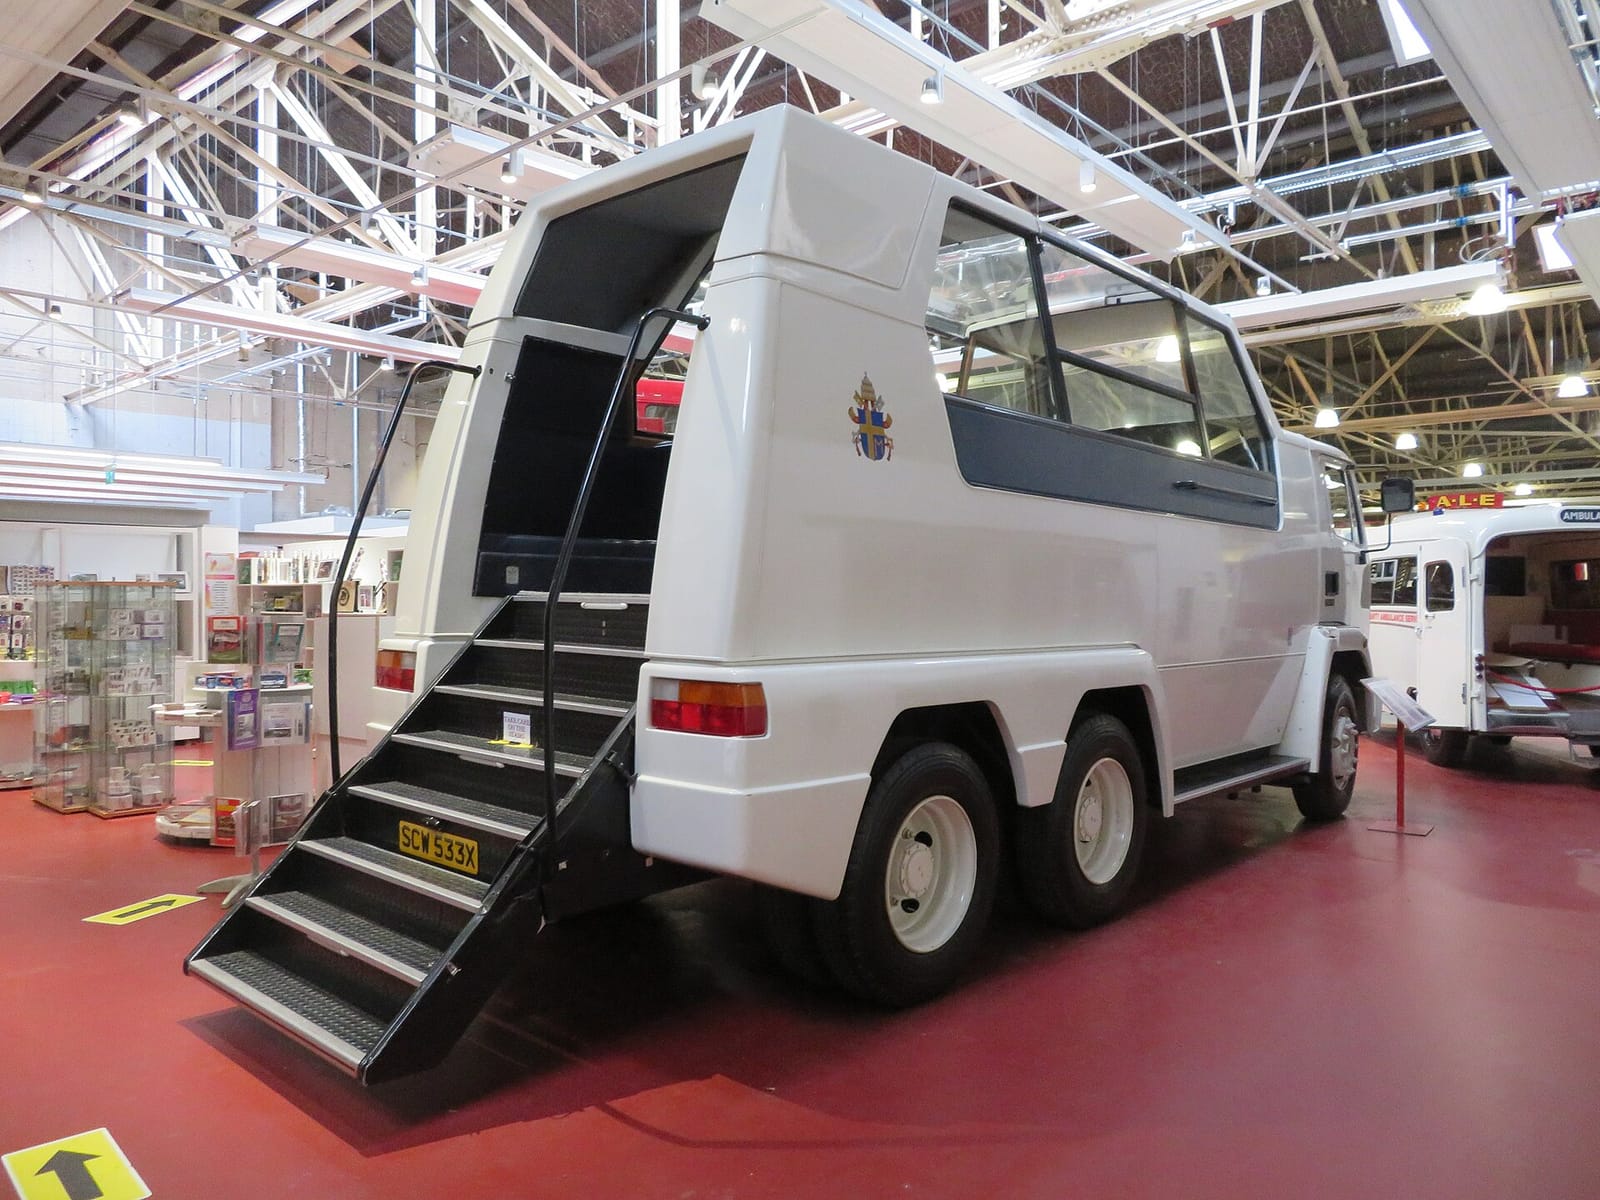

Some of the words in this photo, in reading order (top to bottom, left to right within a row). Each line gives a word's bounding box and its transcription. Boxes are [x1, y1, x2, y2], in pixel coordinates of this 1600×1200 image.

[1563, 511, 1600, 520] AMBULA
[401, 825, 430, 855] SCW
[433, 835, 476, 869] 533X
